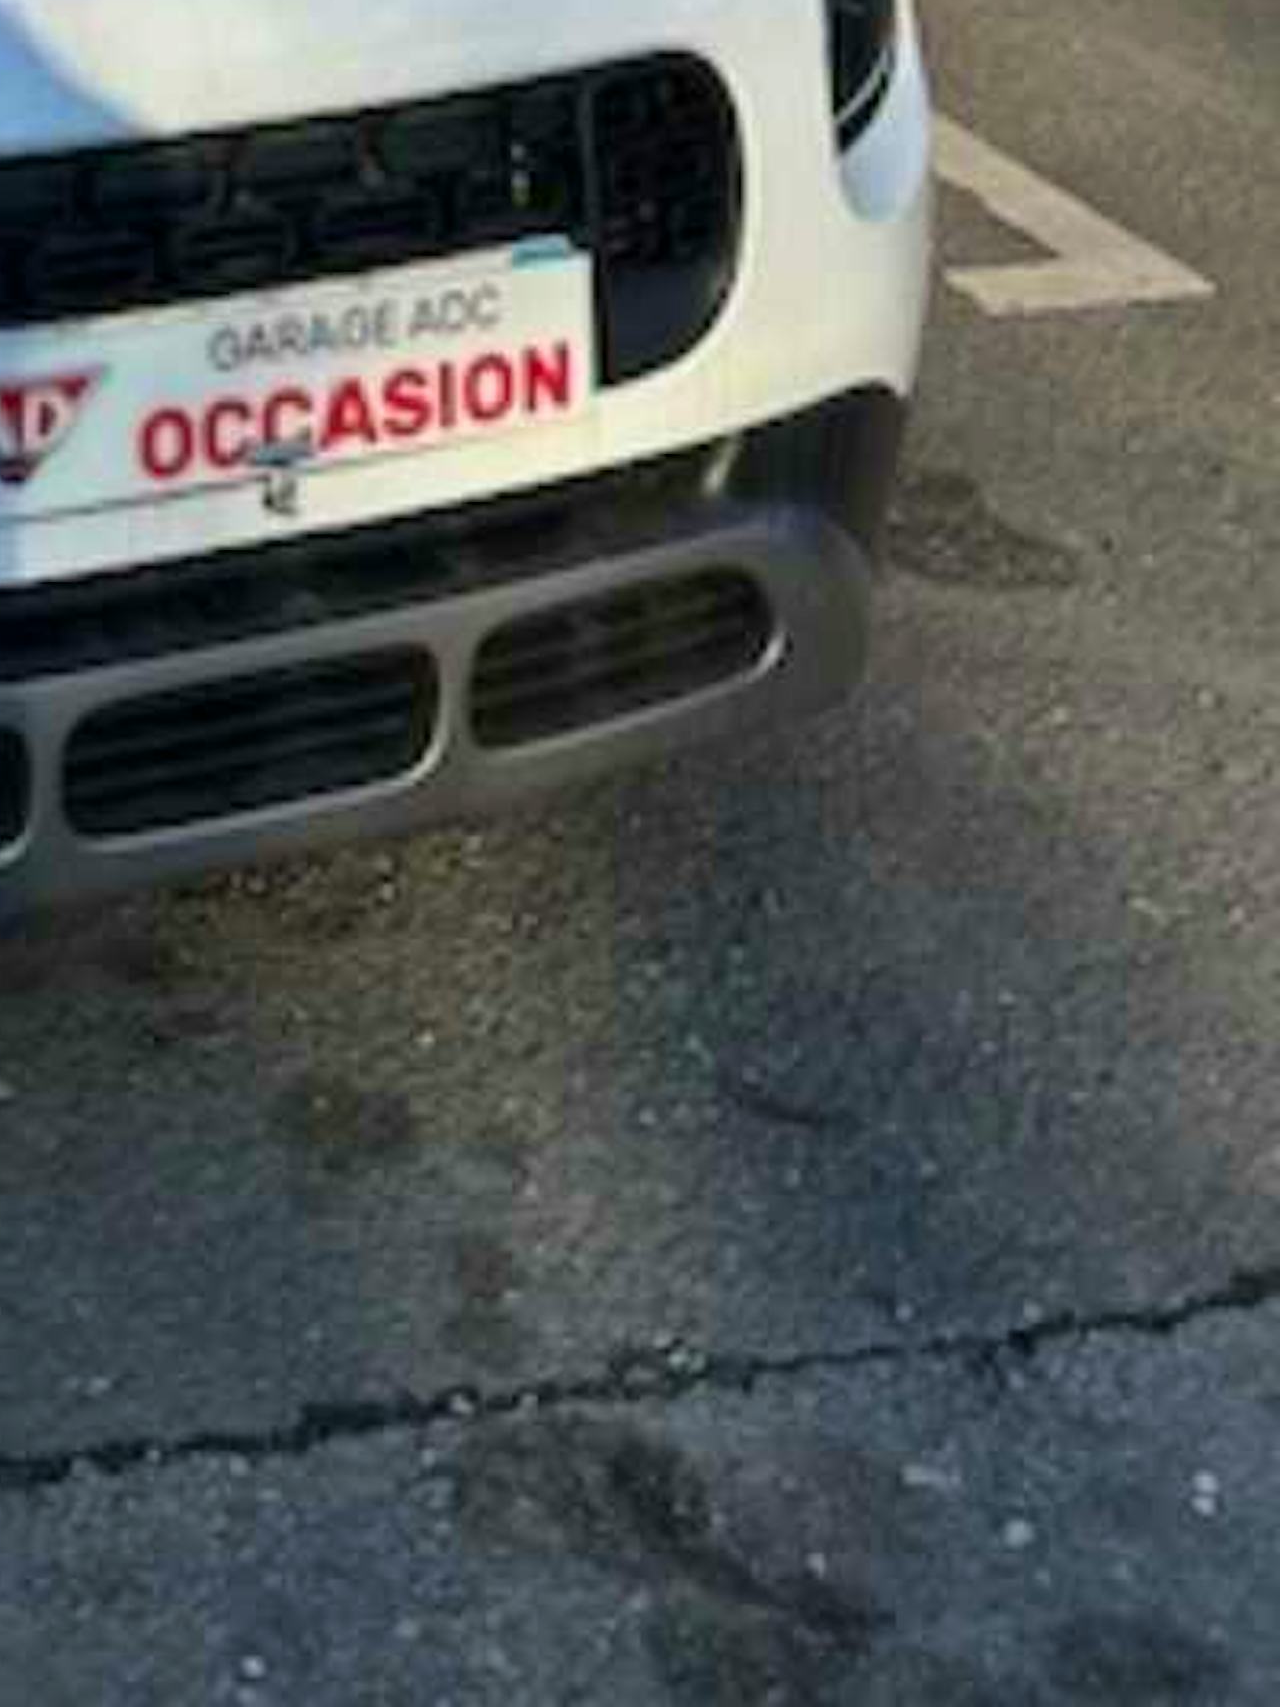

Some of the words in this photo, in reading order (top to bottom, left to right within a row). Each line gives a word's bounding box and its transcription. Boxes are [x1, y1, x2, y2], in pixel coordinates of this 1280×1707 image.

[207, 299, 401, 371] GARAGE
[409, 282, 502, 339] ADC
[137, 342, 571, 479] OCCASION
